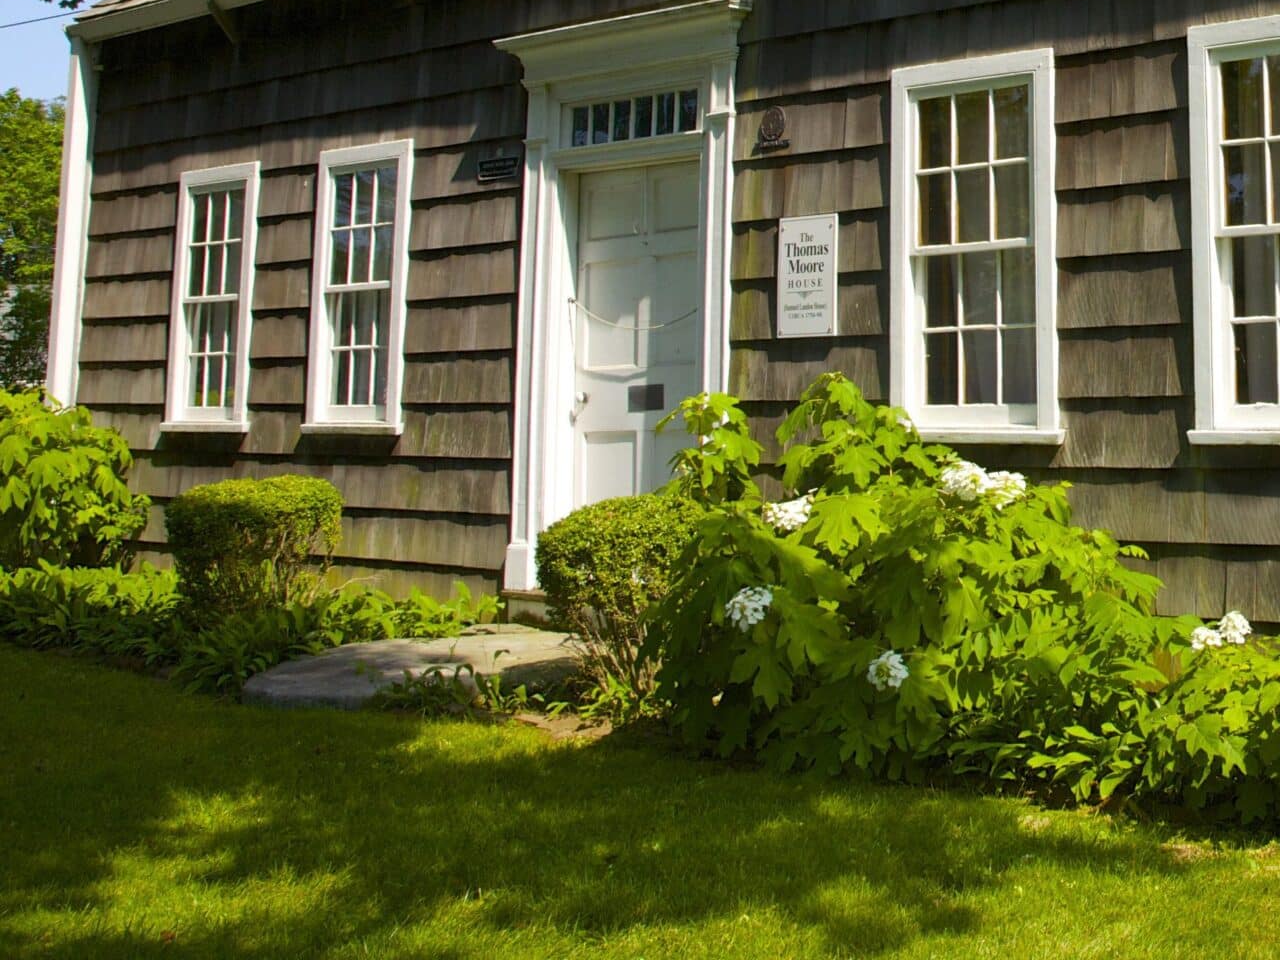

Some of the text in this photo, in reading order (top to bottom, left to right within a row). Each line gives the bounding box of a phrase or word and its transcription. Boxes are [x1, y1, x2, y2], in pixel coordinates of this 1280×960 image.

[800, 232, 814, 242] The
[784, 243, 829, 257] Thomas
[787, 259, 824, 274] Moore
[788, 278, 823, 288] HOUSE
